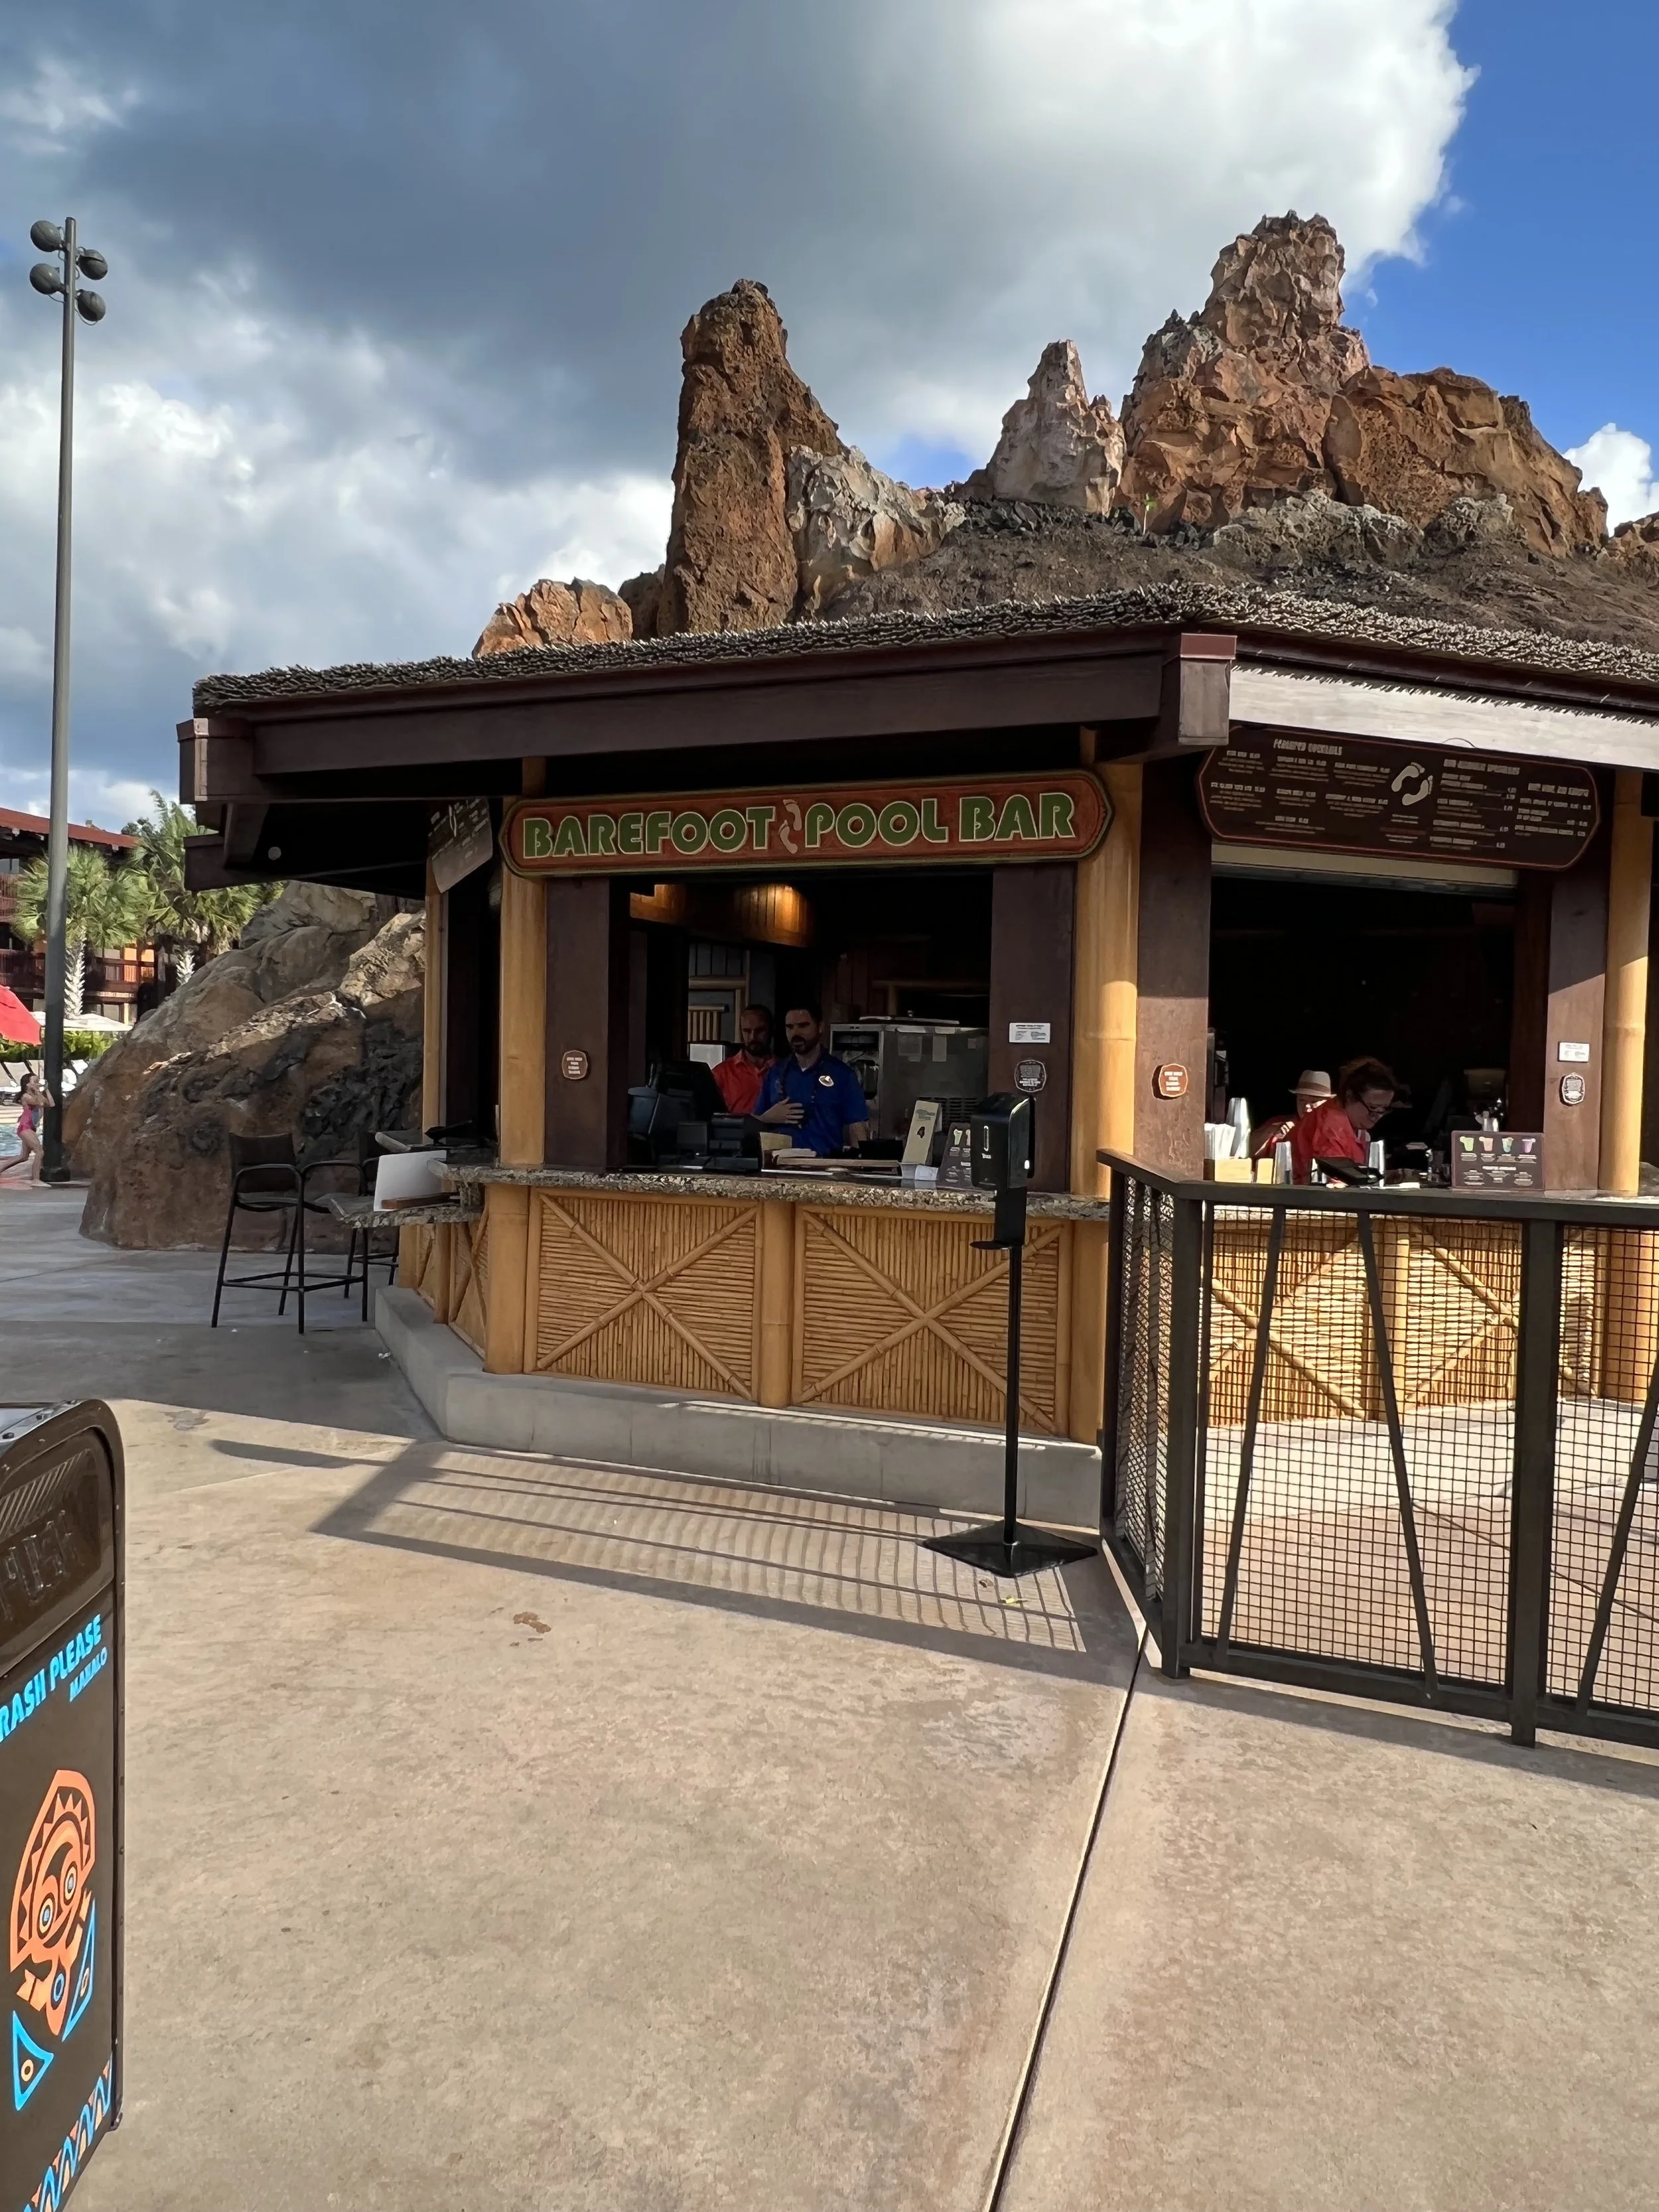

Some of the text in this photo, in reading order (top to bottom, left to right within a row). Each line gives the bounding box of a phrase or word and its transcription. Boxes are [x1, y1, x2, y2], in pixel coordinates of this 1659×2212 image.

[523, 806, 776, 859] BAREFOOT
[805, 798, 949, 848] POOL
[959, 792, 1076, 842] BAR
[50, 1613, 102, 1692] PLEASE
